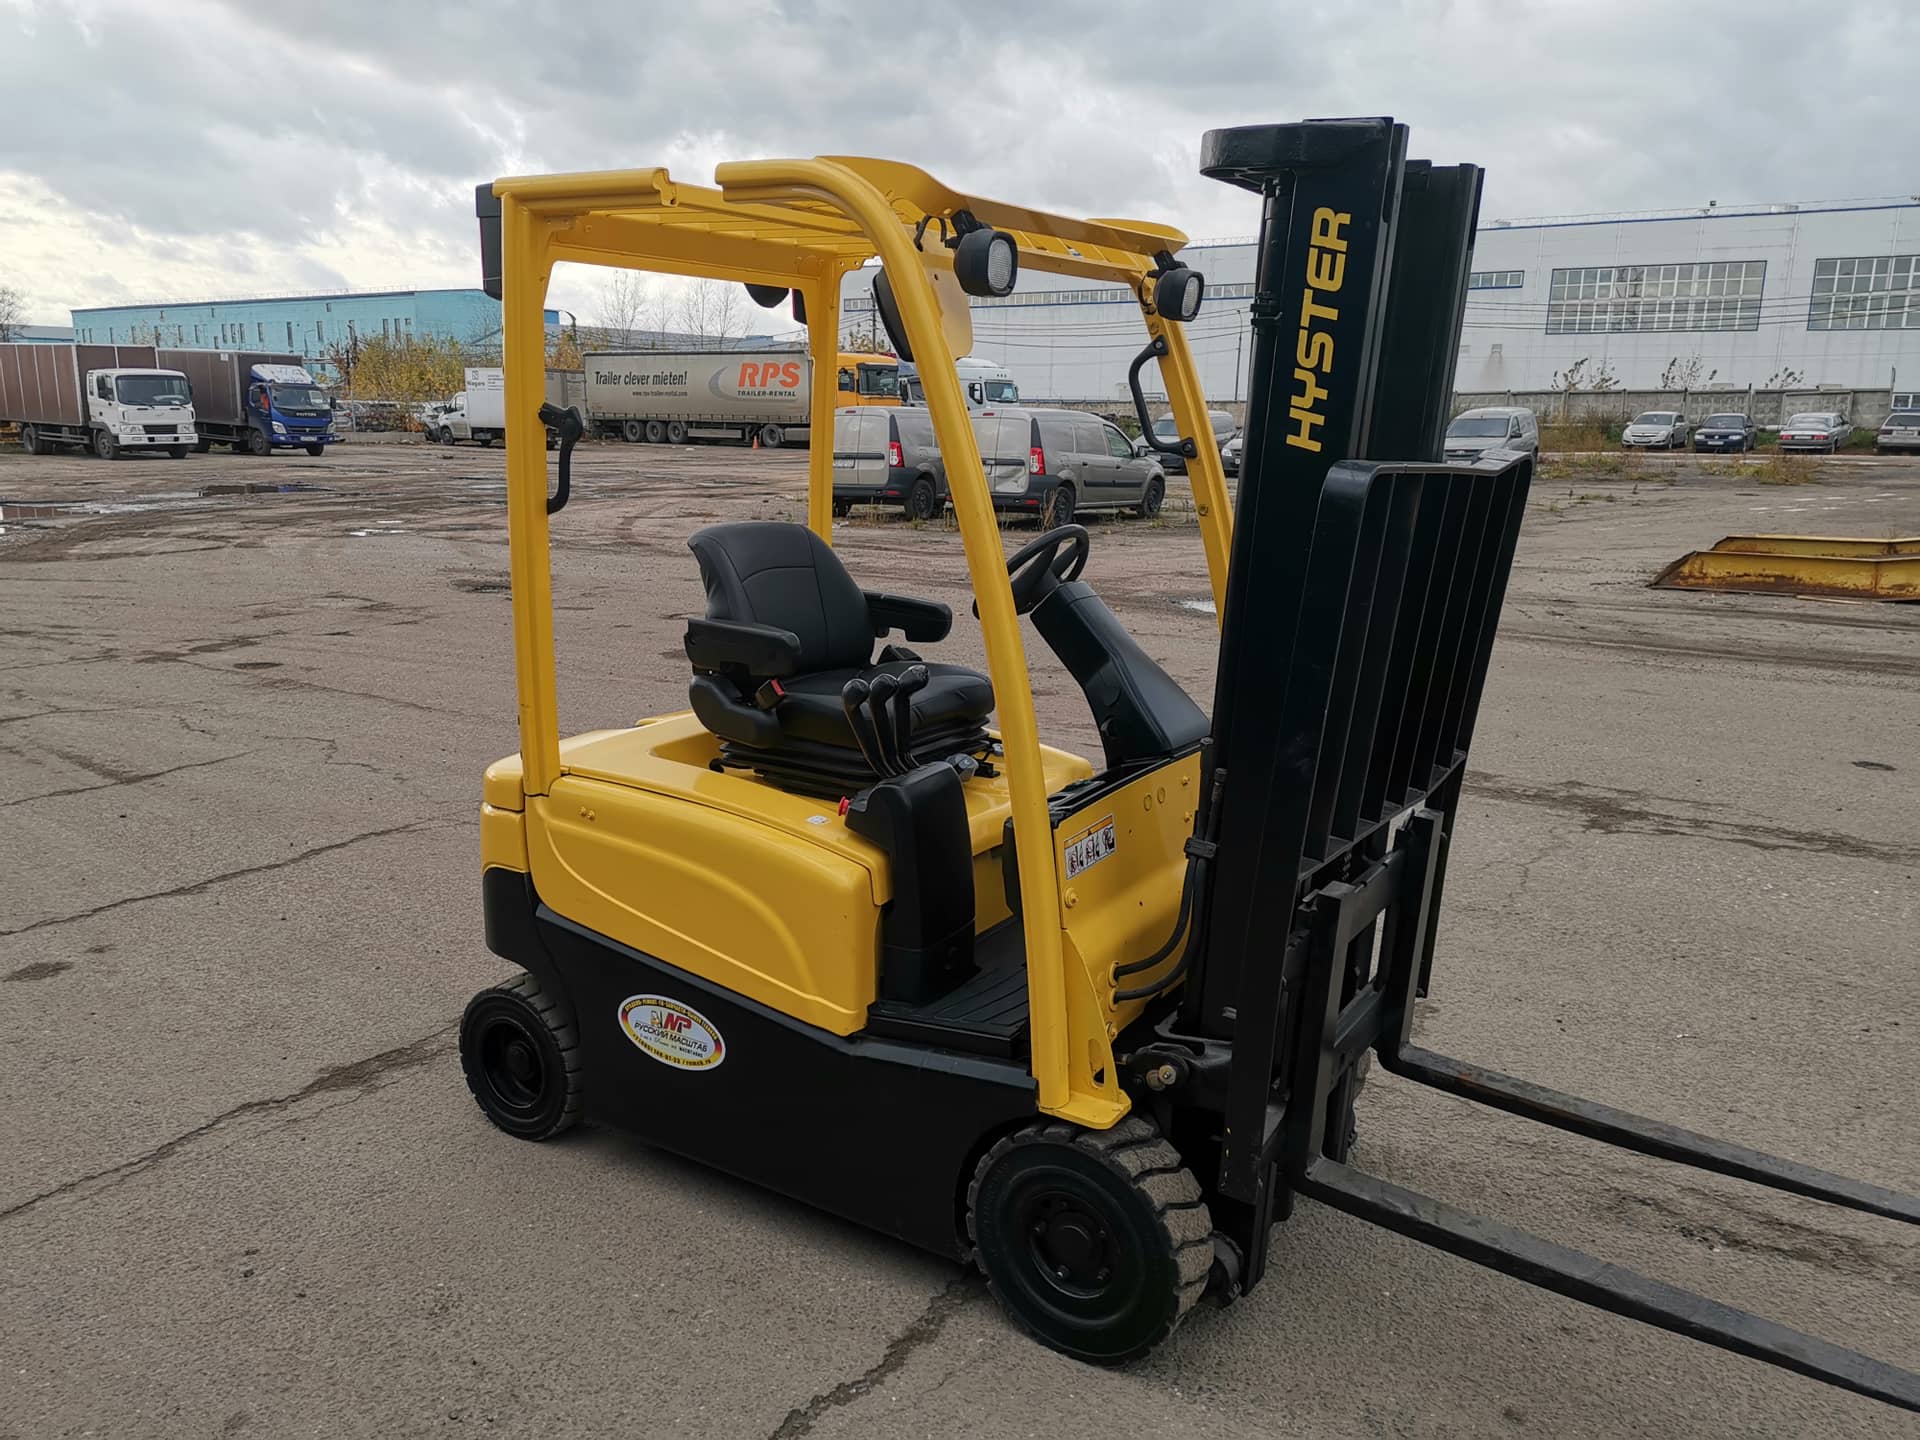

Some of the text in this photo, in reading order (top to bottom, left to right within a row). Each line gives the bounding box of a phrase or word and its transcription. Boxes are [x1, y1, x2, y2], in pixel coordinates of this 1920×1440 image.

[1286, 207, 1351, 452] HYSTER
[595, 371, 688, 385] Trailer clever mieten!
[738, 362, 801, 388] RPS
[669, 1034, 708, 1053] МАСШТАБ
